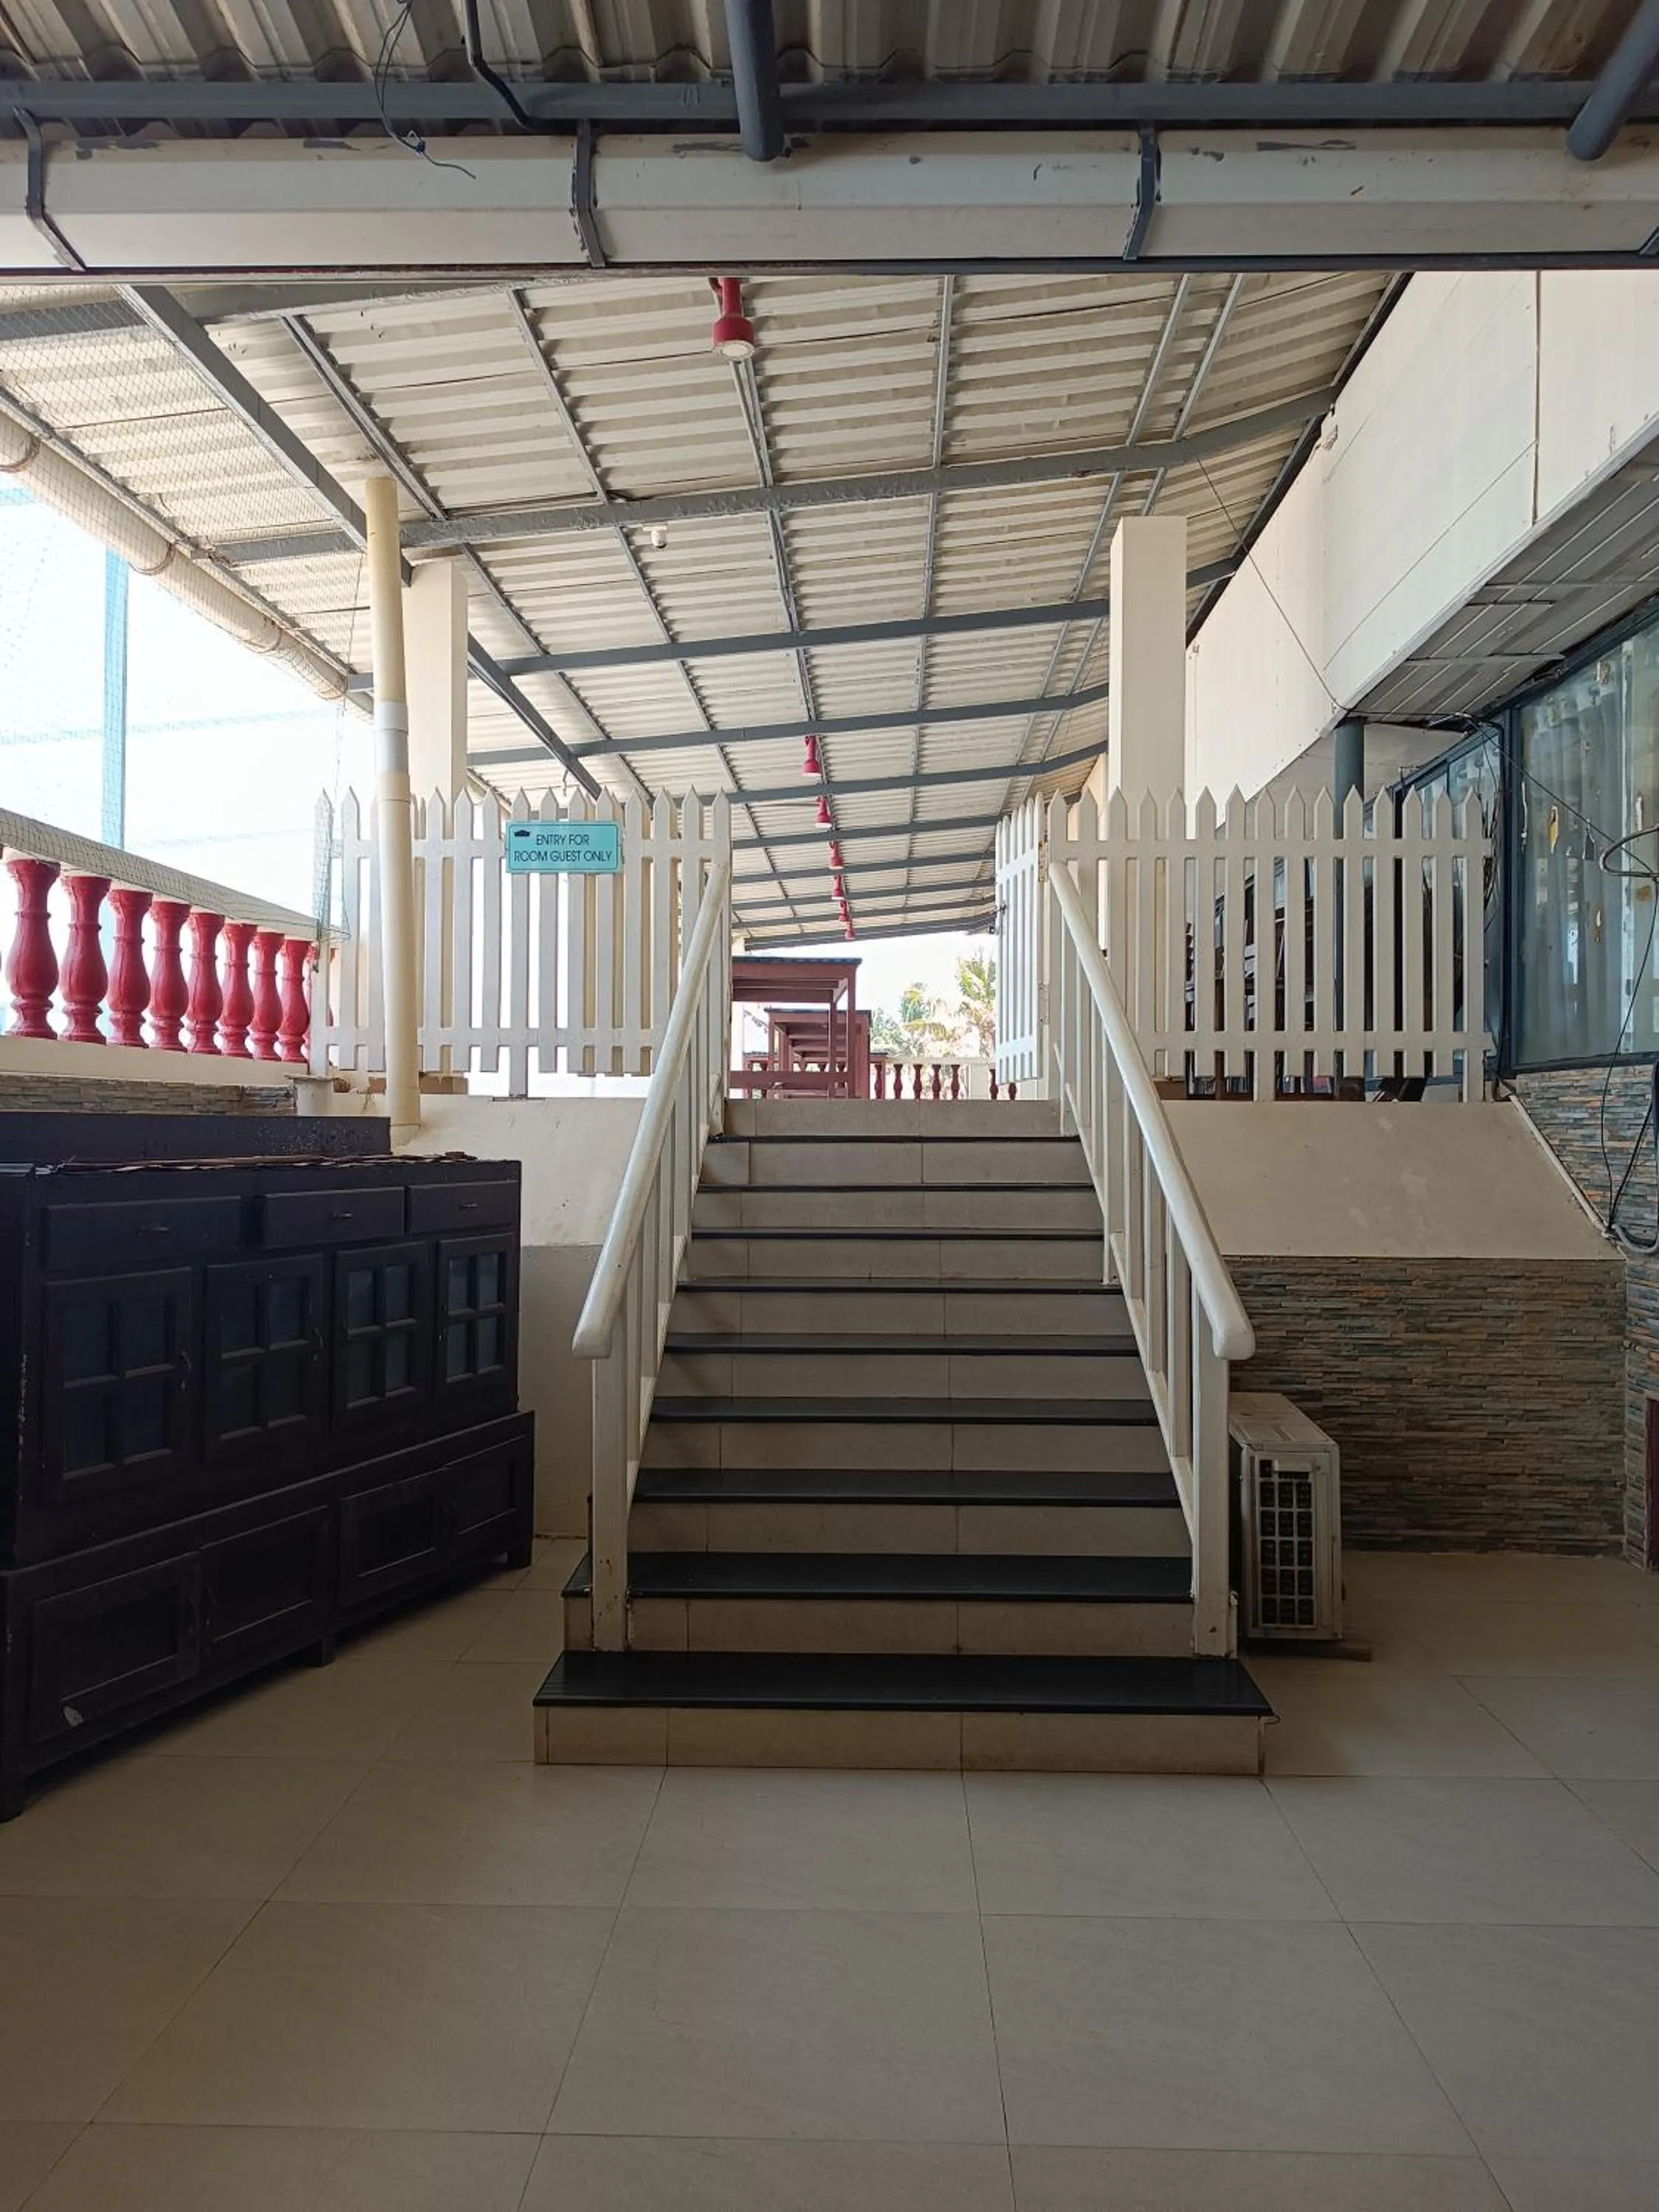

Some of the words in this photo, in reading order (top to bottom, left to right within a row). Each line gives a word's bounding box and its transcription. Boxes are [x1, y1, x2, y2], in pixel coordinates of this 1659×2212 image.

[536, 834, 566, 846] ENTRY
[568, 834, 589, 846] FOR
[514, 850, 548, 862] ROOM
[550, 850, 582, 862] GUEST
[583, 850, 613, 862] ONLY
